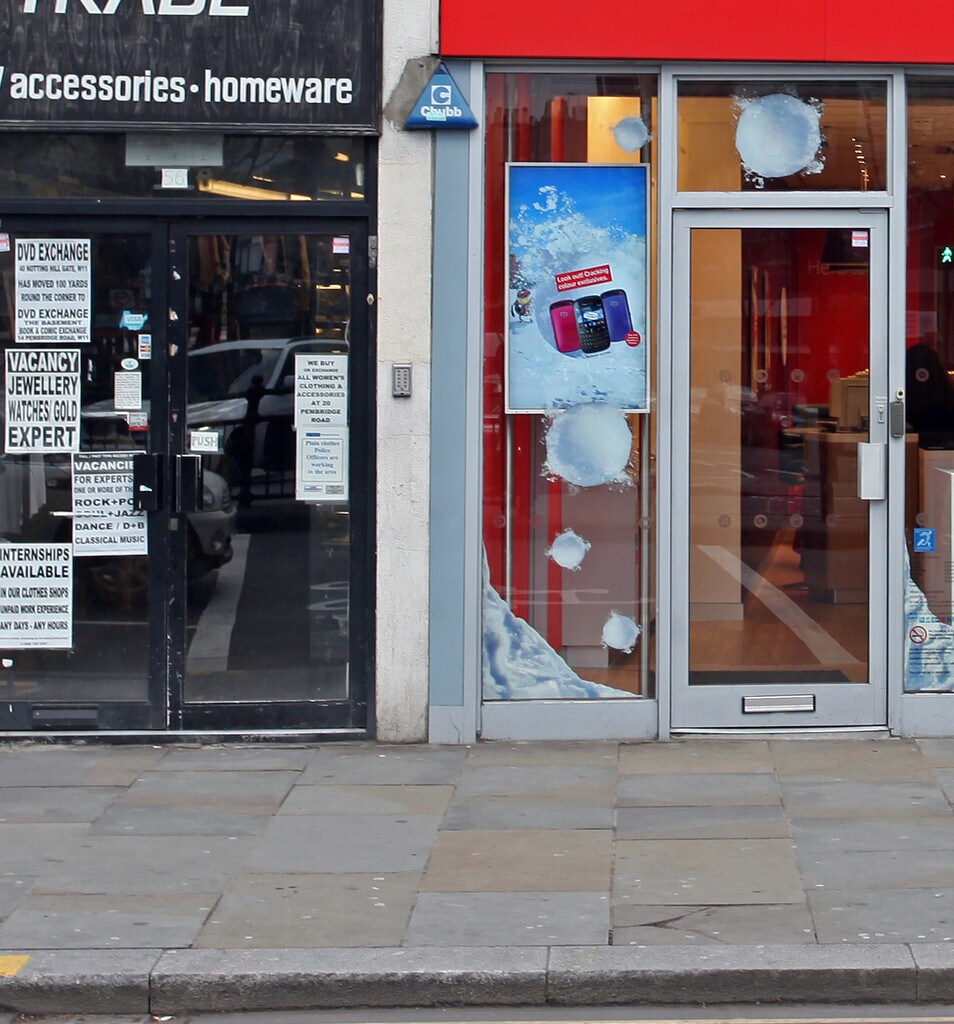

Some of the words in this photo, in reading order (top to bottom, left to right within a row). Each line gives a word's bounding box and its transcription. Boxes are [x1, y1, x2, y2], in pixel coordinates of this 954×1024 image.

[204, 69, 353, 104] homeware
[420, 105, 463, 118] Chubb
[17, 243, 36, 261] DVD
[39, 243, 89, 261] EXCHANGE
[557, 274, 572, 283] Look
[18, 280, 31, 288] HAS
[33, 280, 54, 288] MOVED
[55, 280, 67, 288] 100
[68, 280, 88, 288] YARDS
[558, 281, 577, 290] colour
[21, 293, 40, 301] ROUND
[42, 293, 52, 301] THE
[54, 293, 76, 301] CORNER
[78, 293, 86, 301] TO
[17, 309, 36, 318] DVD
[39, 309, 89, 318] EXCHANGE
[9, 352, 78, 372] VACANCY
[9, 376, 78, 396] JEWELLERY
[54, 400, 77, 422] GOLD
[9, 426, 76, 447] EXPERT
[192, 436, 218, 448] PUSH
[75, 461, 134, 471] VACANCIE
[74, 476, 92, 484] FOR
[94, 475, 134, 484] EXPERTS
[75, 499, 134, 507] ROCK+PO
[75, 523, 113, 531] DANCE
[123, 522, 145, 530] D+B
[75, 537, 118, 545] CLASSICAL
[0, 548, 69, 561] INTERNSHIPS
[1, 566, 69, 578] AVAILABLE
[0, 588, 6, 598] IN
[8, 588, 21, 598] OUR
[22, 588, 47, 598] CLOTHES
[49, 588, 69, 598] SHOPS
[0, 605, 19, 613] UNPAID
[20, 605, 35, 613] WORK
[37, 605, 69, 613] EXPERIENCE
[0, 622, 12, 630] ANY
[14, 622, 29, 630] DAYS
[33, 622, 46, 630] ANY
[47, 621, 69, 630] HOURS
